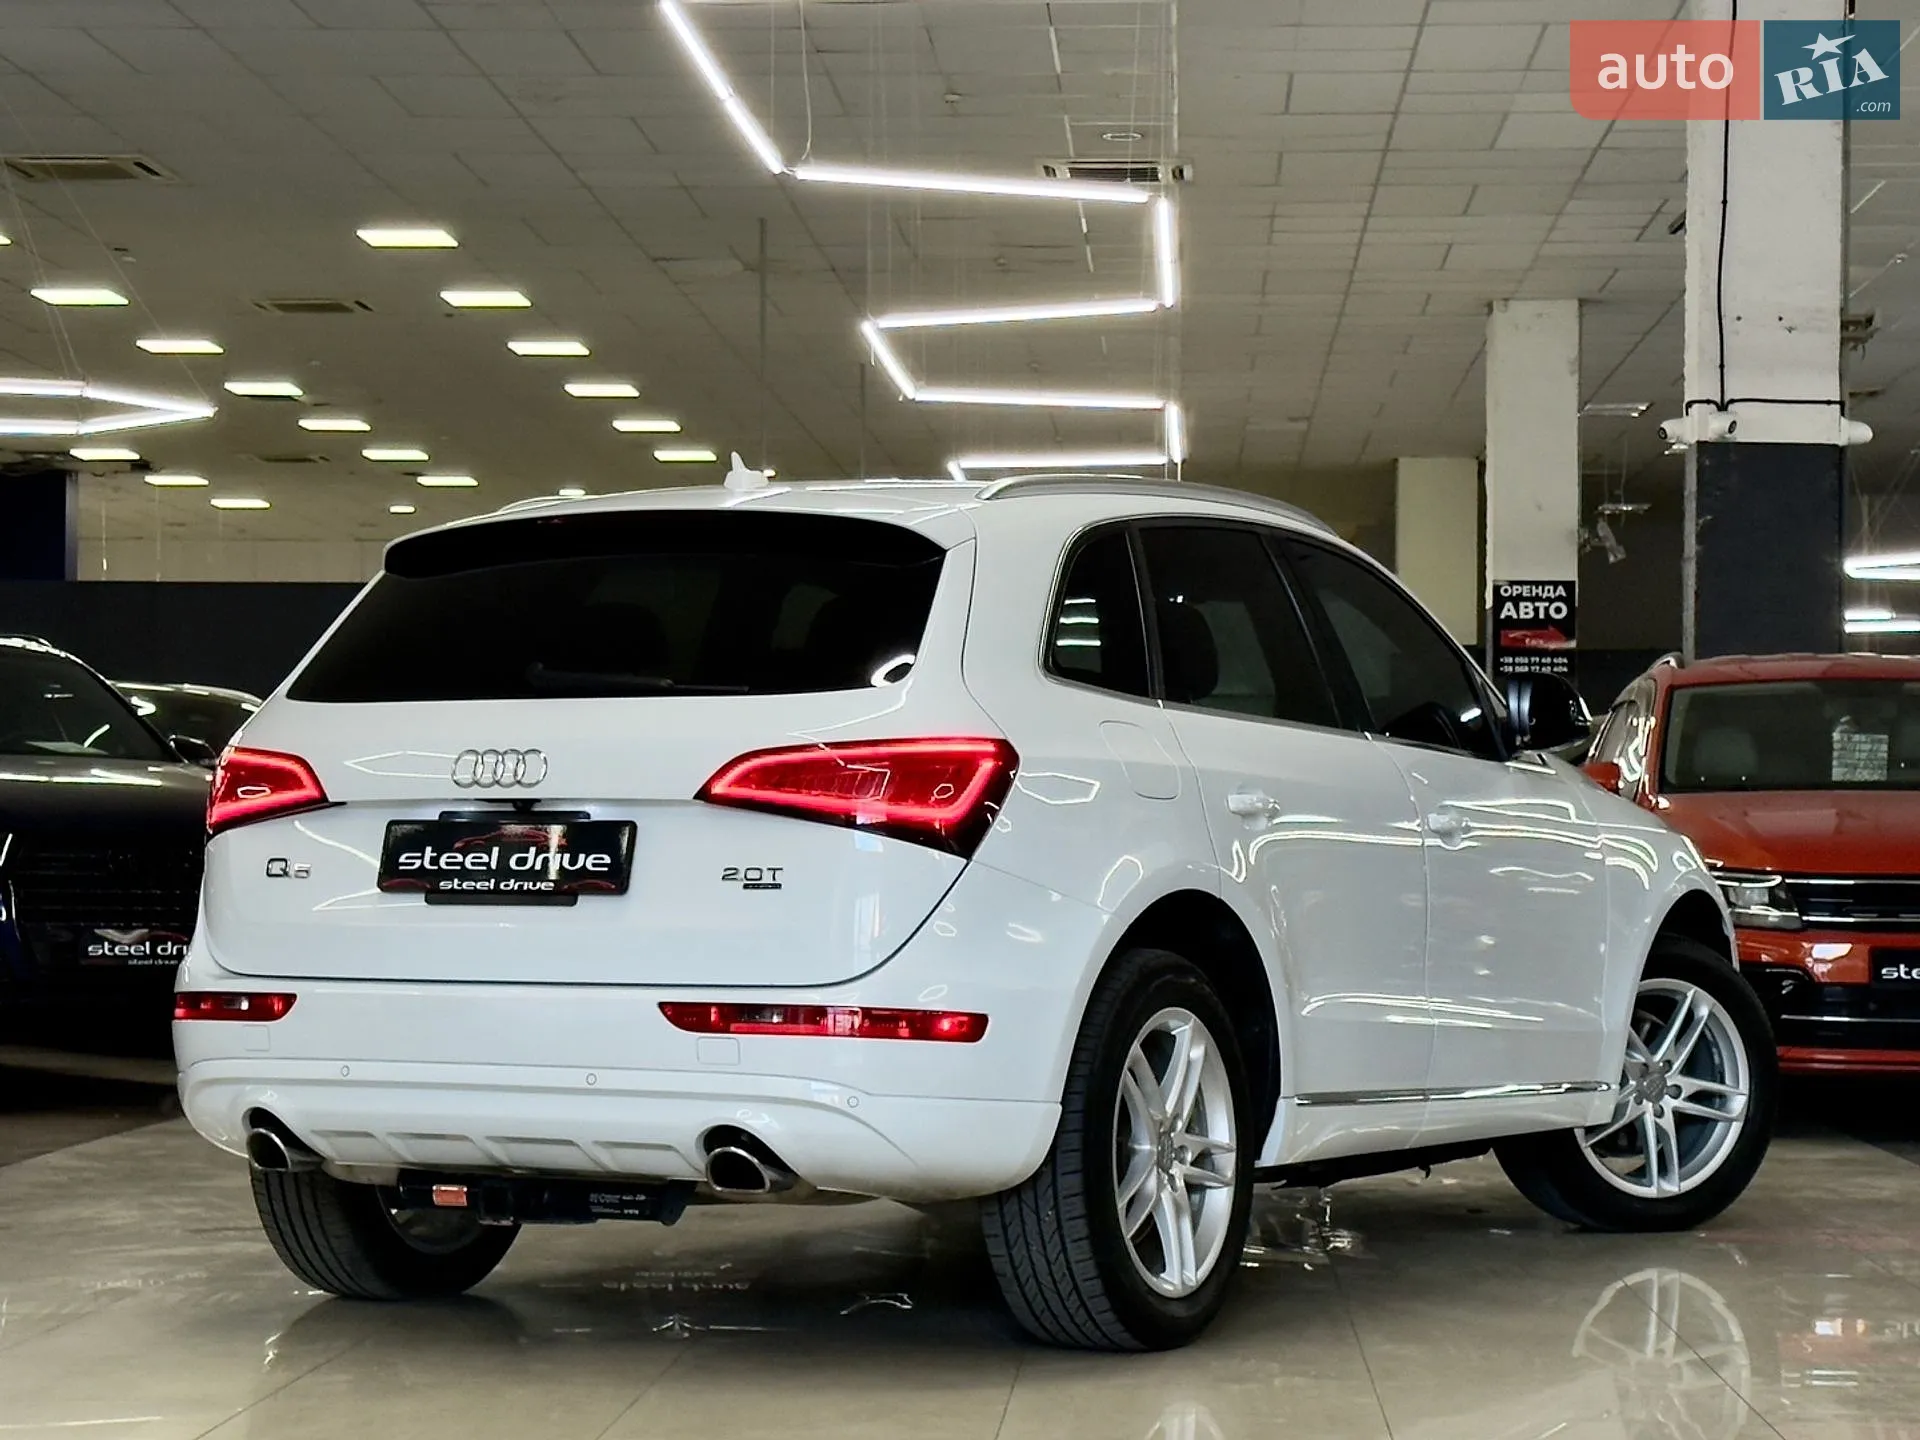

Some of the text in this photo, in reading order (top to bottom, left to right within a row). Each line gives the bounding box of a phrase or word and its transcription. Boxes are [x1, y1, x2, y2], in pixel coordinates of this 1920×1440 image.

[1500, 585, 1567, 599] ОРЕНДА
[1500, 601, 1568, 620] АВТО
[399, 846, 612, 872] steel drive
[266, 858, 311, 879] Q5
[722, 867, 783, 881] 2.0T
[439, 879, 555, 891] steel drive
[88, 941, 150, 956] steel
